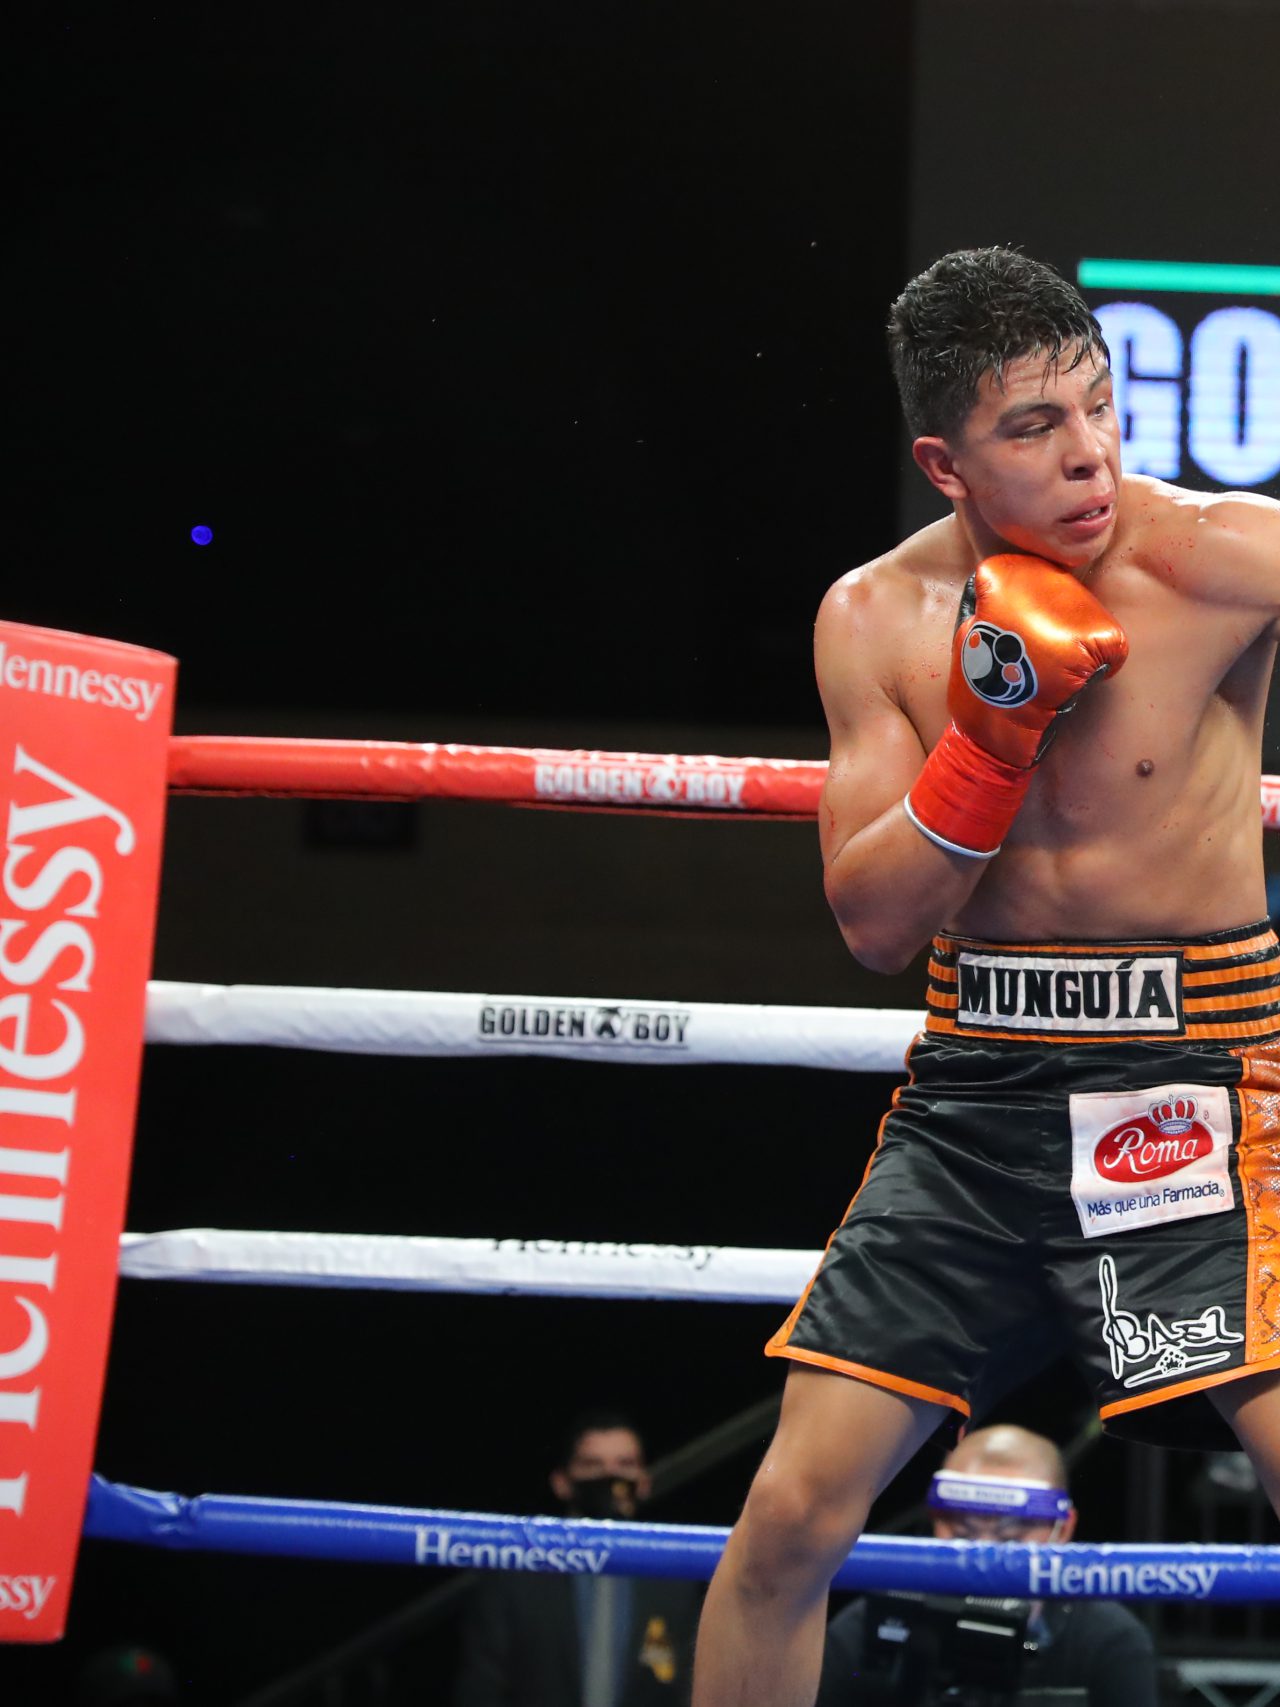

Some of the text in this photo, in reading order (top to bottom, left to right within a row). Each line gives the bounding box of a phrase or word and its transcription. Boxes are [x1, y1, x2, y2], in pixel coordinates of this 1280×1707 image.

[535, 764, 746, 806] GOLDEN BOY
[958, 958, 1176, 1018] MUNGUÍA
[480, 1006, 690, 1043] GOLDEN BOY
[1103, 1126, 1199, 1175] Roma
[1087, 1201, 1112, 1217] Más
[1114, 1199, 1137, 1216] que
[1138, 1193, 1160, 1209] una
[414, 1525, 611, 1575] Hennessy
[1029, 1555, 1220, 1599] Hennessy
